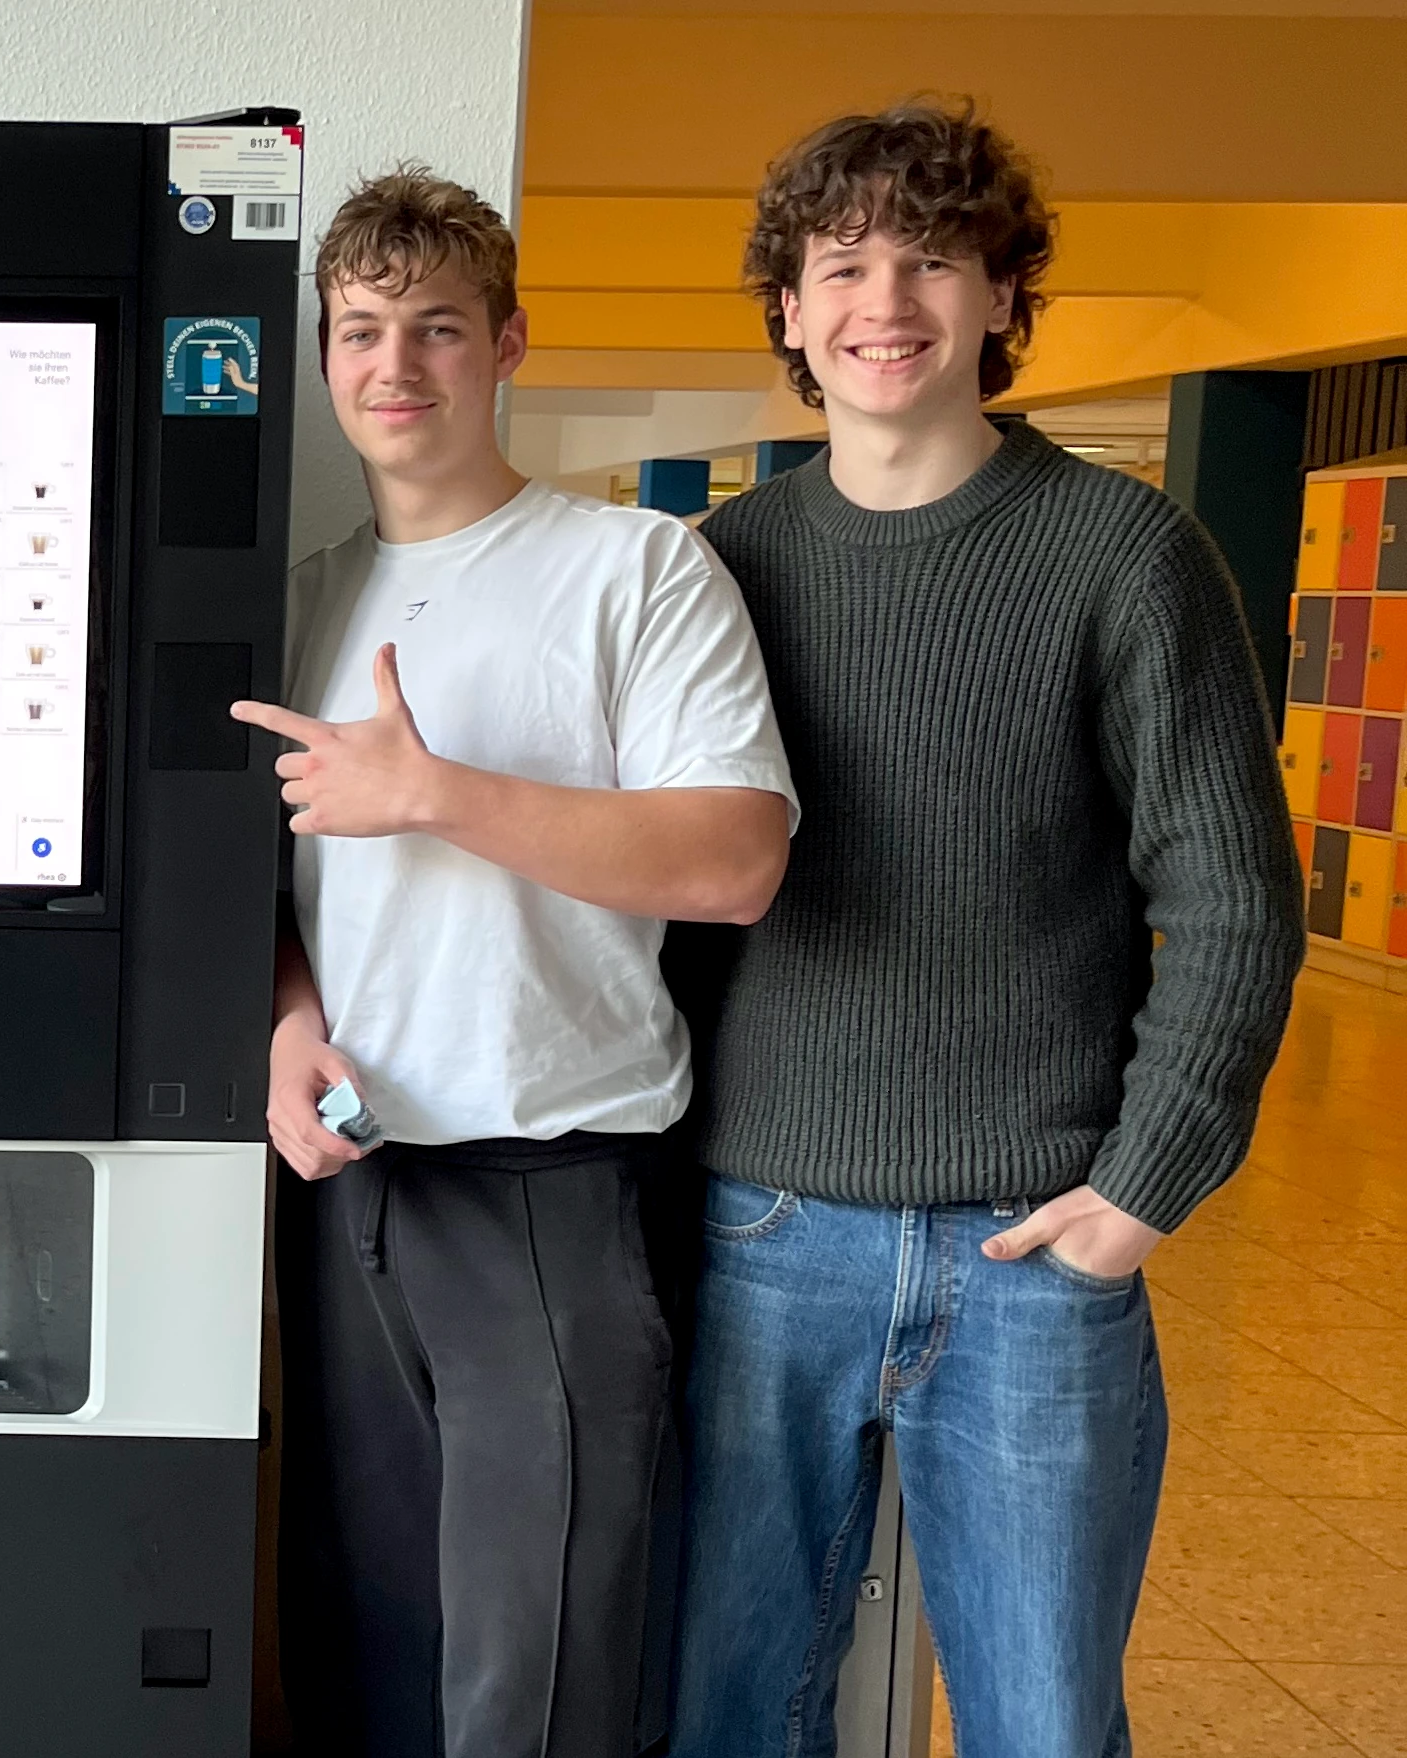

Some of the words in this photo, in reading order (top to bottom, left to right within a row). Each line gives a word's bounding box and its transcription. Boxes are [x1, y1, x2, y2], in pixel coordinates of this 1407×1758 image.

[250, 137, 277, 149] 8137
[169, 325, 195, 353] DEINEN
[195, 318, 234, 331] EIGENEN
[233, 325, 257, 356] BECHER
[9, 350, 27, 359] Wie
[29, 349, 72, 360] möchten
[34, 375, 71, 385] Kaffee?
[37, 873, 56, 881] rhea
